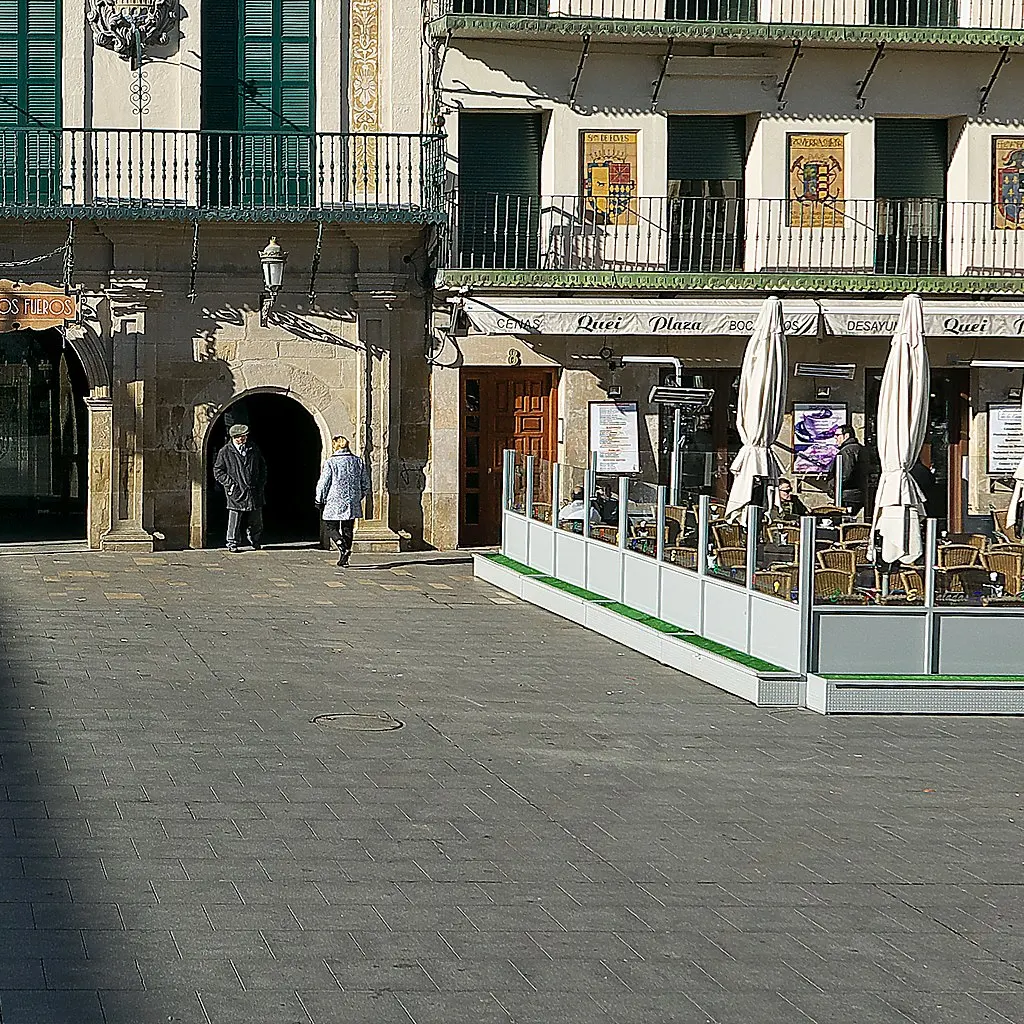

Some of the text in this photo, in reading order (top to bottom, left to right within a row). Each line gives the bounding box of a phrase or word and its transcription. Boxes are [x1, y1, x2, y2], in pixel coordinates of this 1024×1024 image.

[24, 298, 72, 315] FUEROS
[496, 318, 541, 330] CENAS
[576, 314, 623, 332] Quei
[648, 315, 703, 333] Plaza
[943, 317, 988, 334] Quei
[508, 348, 522, 366] 8
